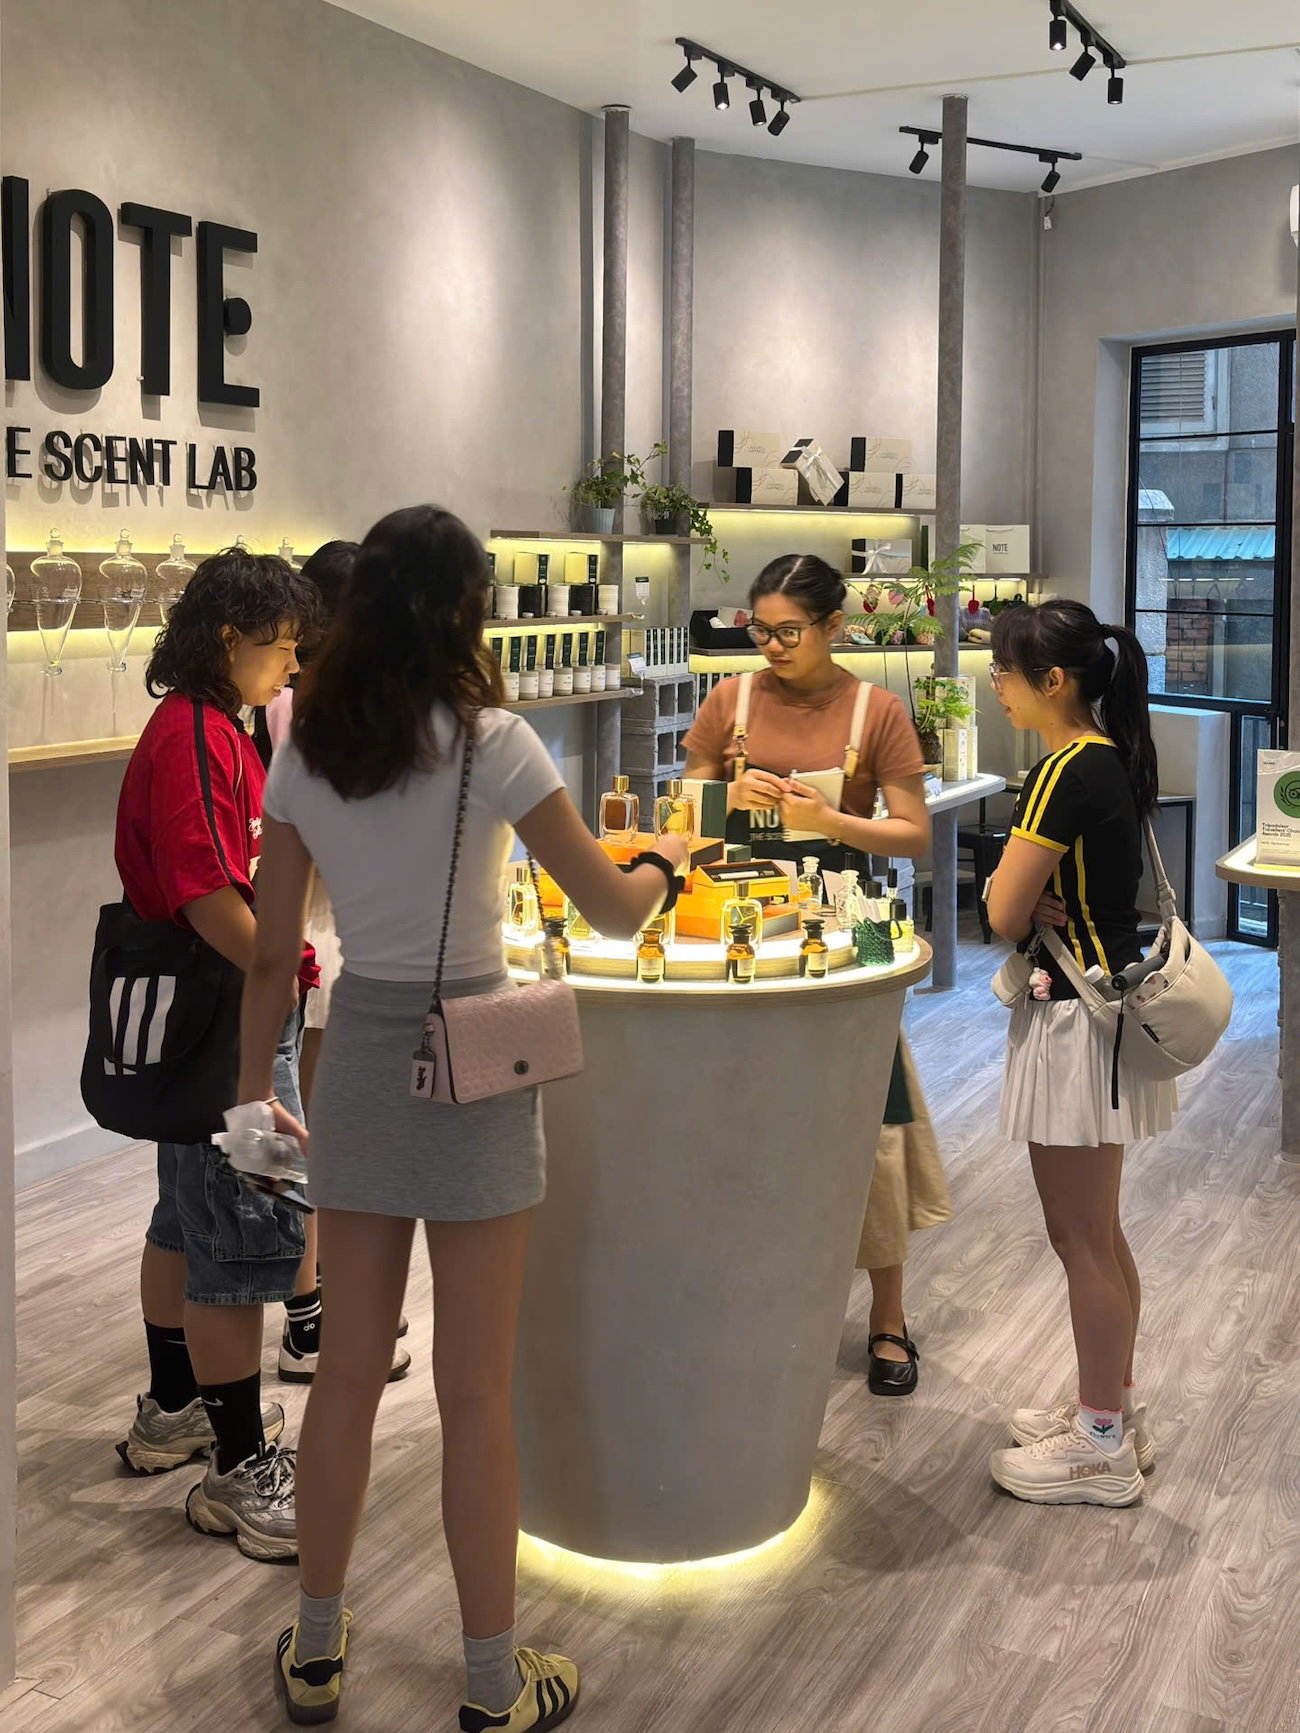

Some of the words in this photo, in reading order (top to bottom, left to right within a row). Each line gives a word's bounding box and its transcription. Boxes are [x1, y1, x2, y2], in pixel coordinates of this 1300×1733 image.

[44, 430, 177, 486] SCENT
[188, 443, 257, 490] LAB
[992, 543, 1008, 552] NOTE
[1069, 1461, 1112, 1481] HOKA
